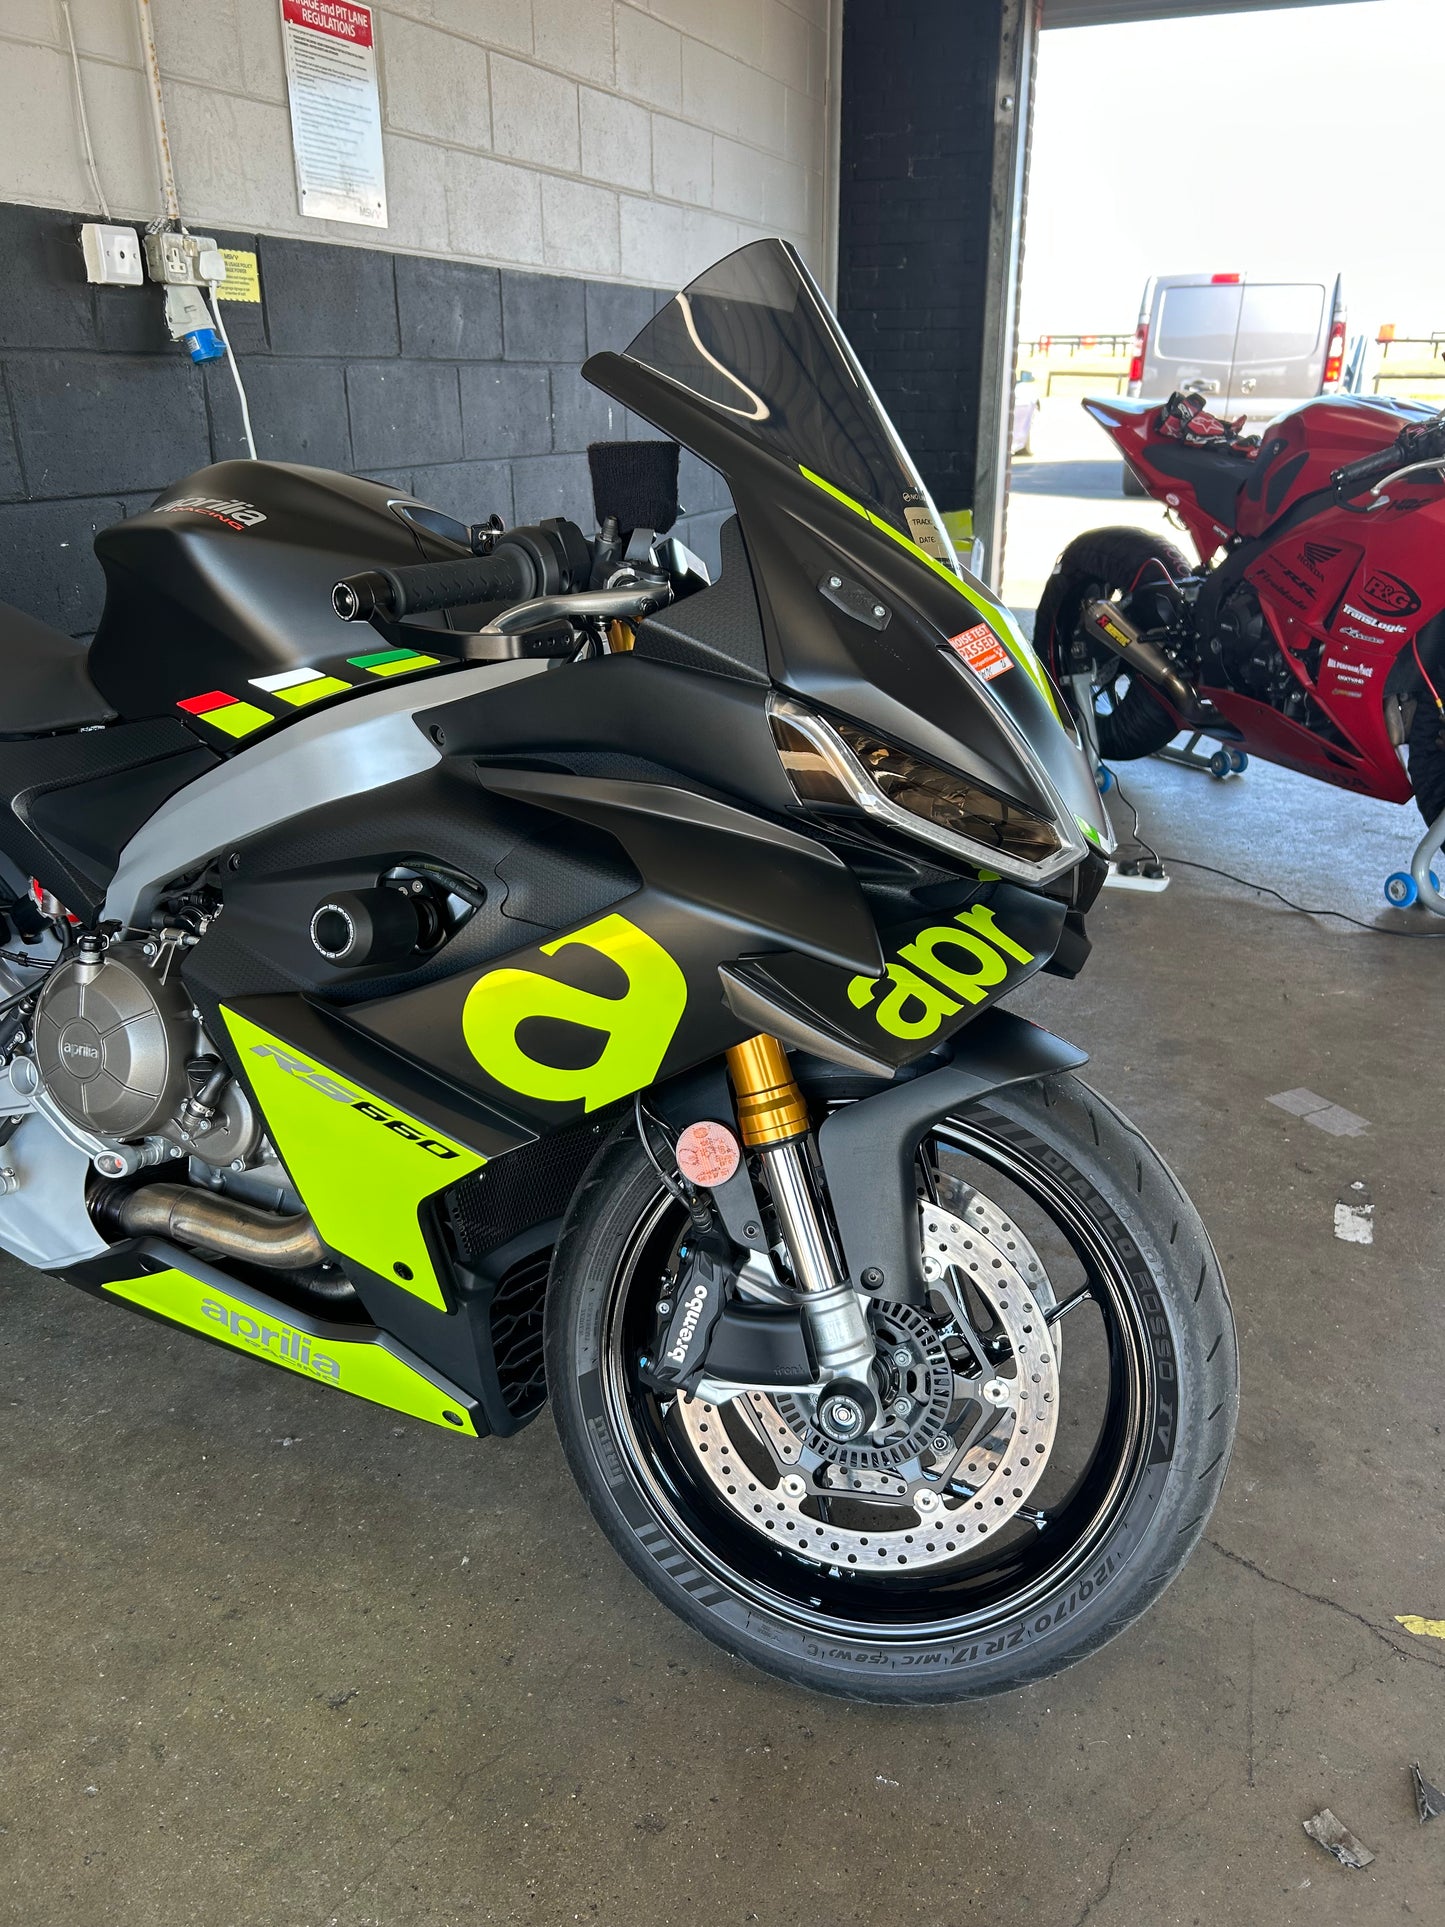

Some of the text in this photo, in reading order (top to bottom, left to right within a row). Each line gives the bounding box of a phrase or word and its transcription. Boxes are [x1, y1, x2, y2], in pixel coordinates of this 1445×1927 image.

[301, 7, 356, 37] REGULATIONS
[319, 3, 335, 16] and
[335, 5, 348, 20] PIT
[348, 10, 369, 28] LANE
[154, 497, 268, 528] aprilia
[170, 507, 245, 531] RACING
[1296, 552, 1325, 583] HONDA
[1364, 576, 1411, 609] R&G
[959, 636, 996, 658] PASSED
[973, 625, 990, 639] TEST
[847, 904, 1036, 1041] apr
[63, 1042, 99, 1060] aprilia
[1041, 1149, 1175, 1456] DIABLO ROSSO IV
[200, 1298, 341, 1379] aprilia
[666, 1285, 709, 1364] brembo
[900, 1653, 942, 1665] M/C
